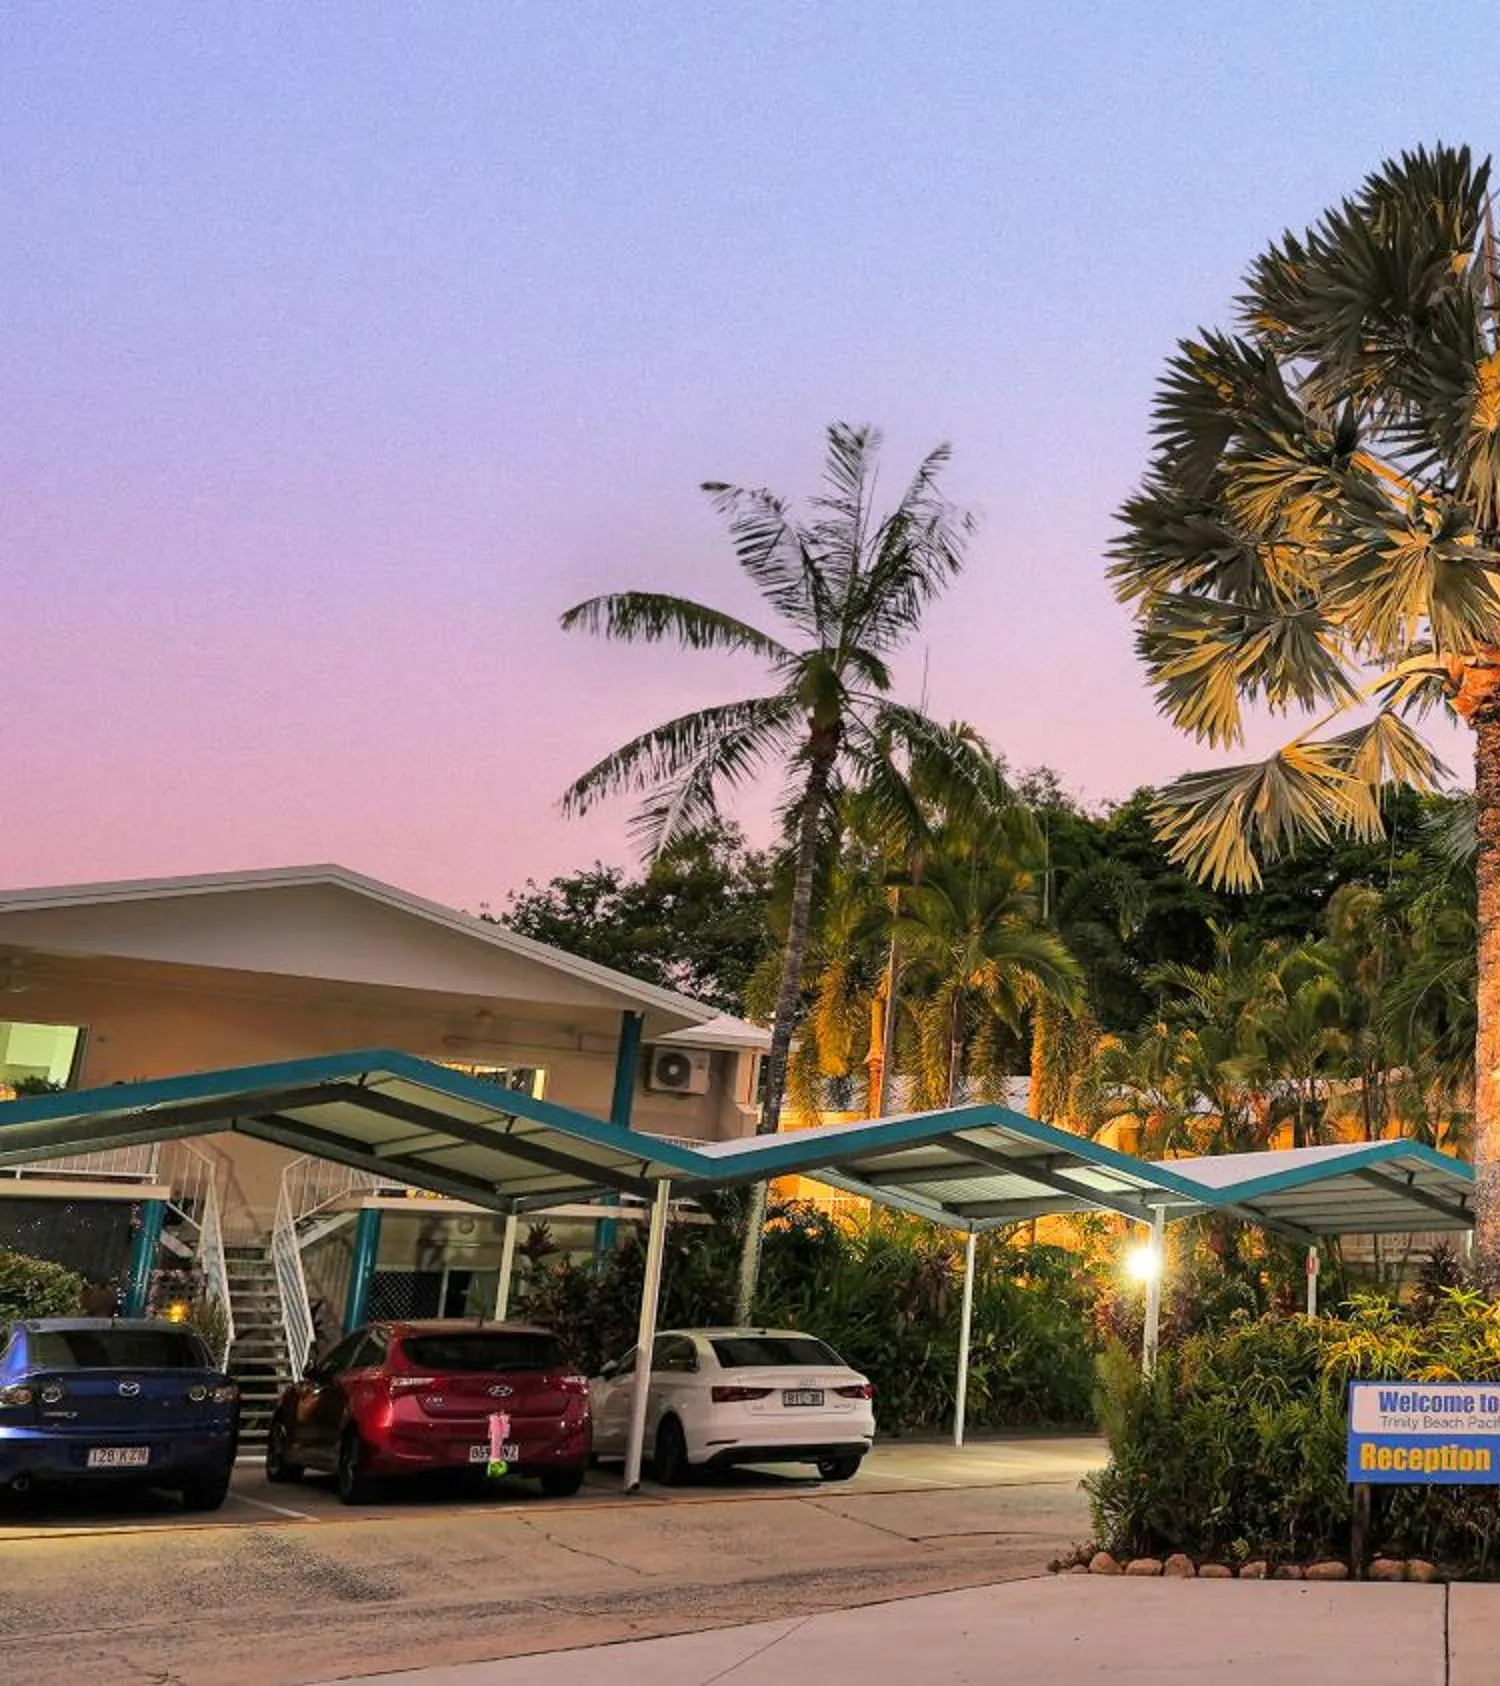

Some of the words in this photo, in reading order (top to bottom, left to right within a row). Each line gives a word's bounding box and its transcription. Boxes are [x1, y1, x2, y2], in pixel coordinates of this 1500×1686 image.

[1378, 1391, 1475, 1413] Welcome
[1380, 1415, 1418, 1430] Trinity
[1423, 1415, 1464, 1429] Beach
[1359, 1443, 1491, 1473] Reception
